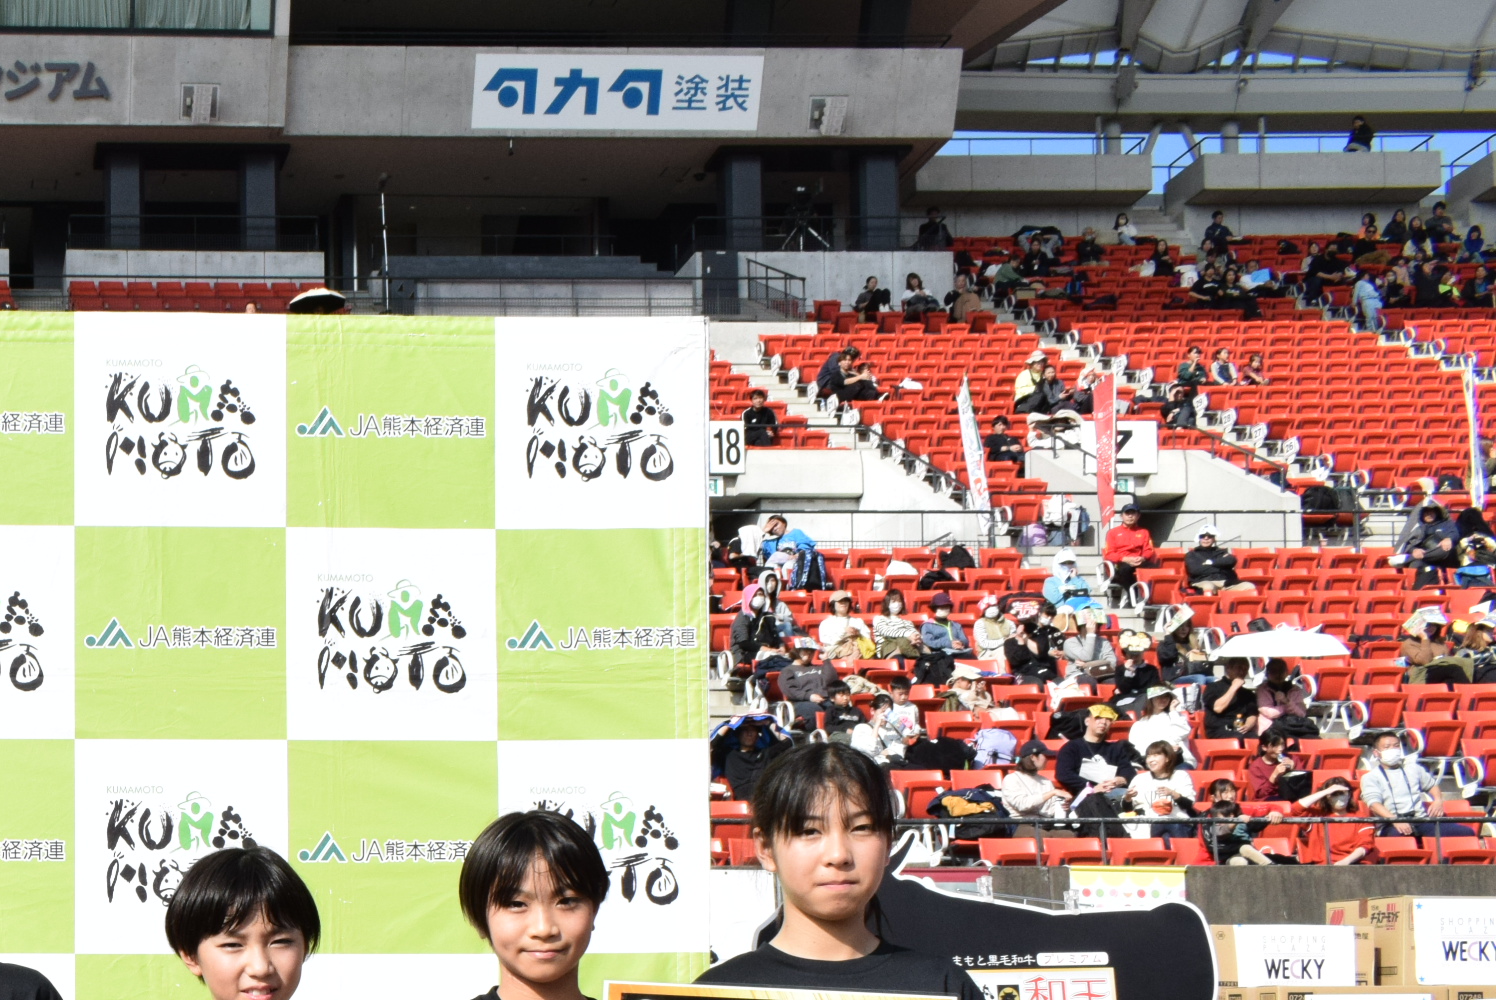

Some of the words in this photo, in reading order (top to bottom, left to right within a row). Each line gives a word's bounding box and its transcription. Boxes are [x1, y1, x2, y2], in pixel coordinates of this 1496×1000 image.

[106, 365, 256, 427] KUMA
[526, 368, 675, 430] KUMA
[350, 414, 485, 437] JA熊本経済連
[713, 428, 741, 466] 18
[106, 427, 256, 480] MOTO
[526, 430, 675, 482] MOTO
[317, 579, 467, 639] KUMA
[139, 626, 276, 649] JA熊本経済連
[560, 626, 696, 650] JA熊本経済連
[317, 640, 467, 693] MOTO
[352, 839, 476, 861] JA熊本経済
[106, 851, 188, 906] MO
[610, 853, 679, 905] TO
[1440, 917, 1496, 926] SHOPPIN
[953, 955, 1036, 966] まもと黒毛和牛
[1264, 959, 1325, 979] WECKY
